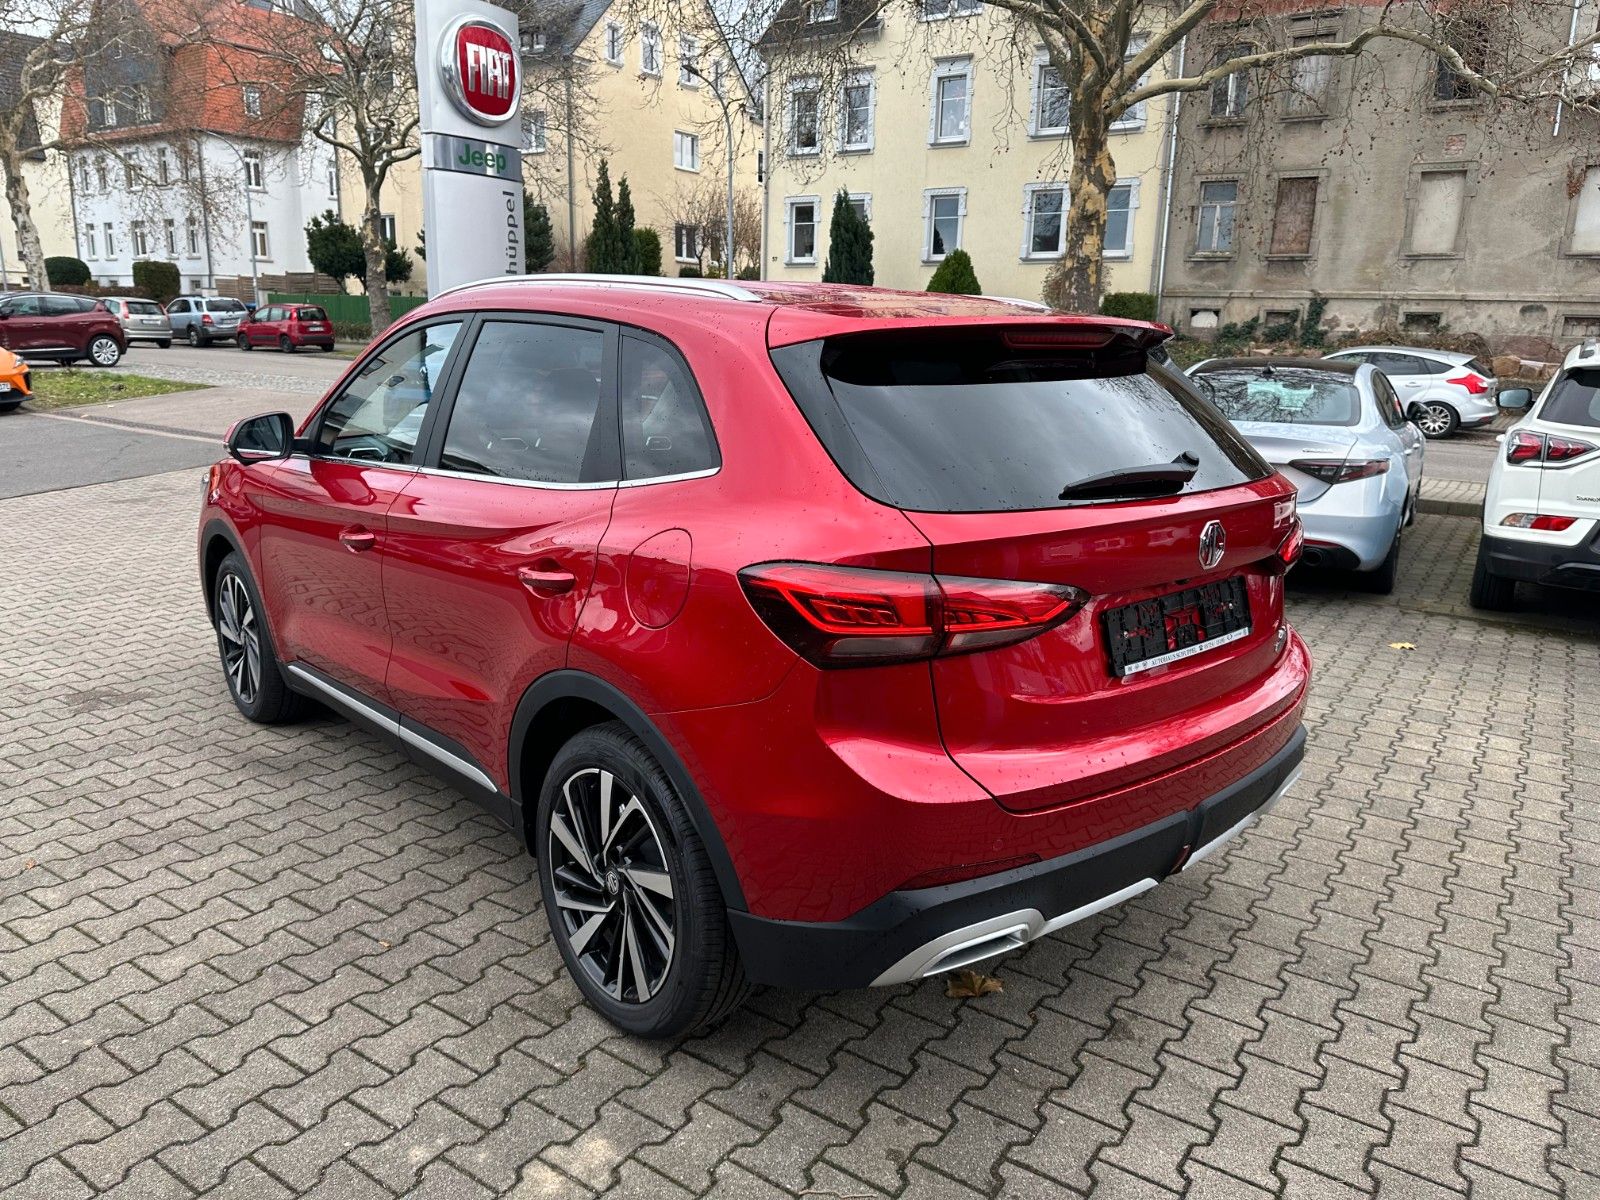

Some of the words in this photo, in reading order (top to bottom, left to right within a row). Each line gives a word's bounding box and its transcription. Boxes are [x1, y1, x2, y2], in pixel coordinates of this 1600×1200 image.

[465, 41, 512, 100] FIAT
[458, 143, 507, 174] Jeep
[502, 190, 519, 275] hüppel
